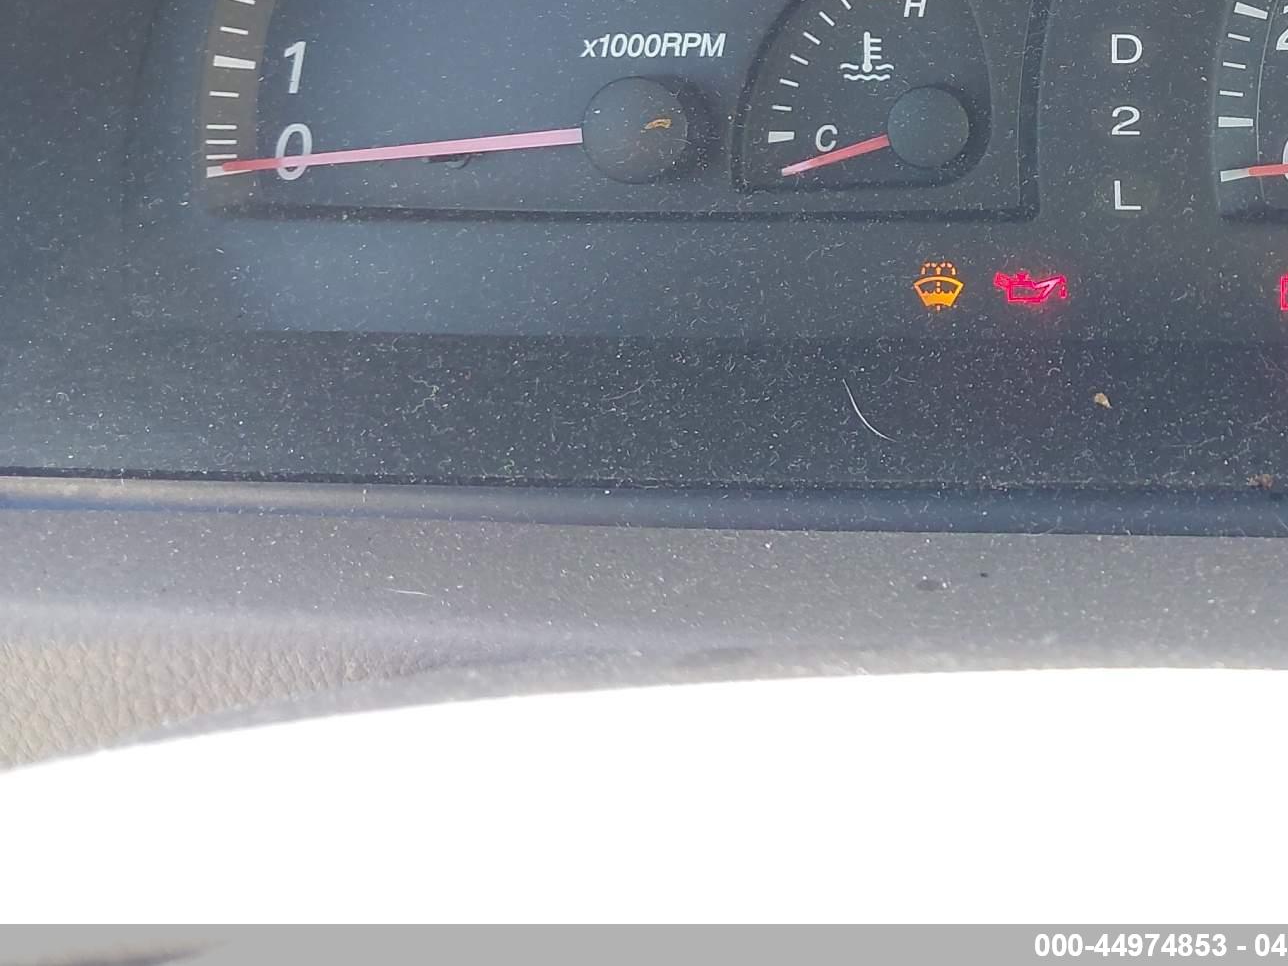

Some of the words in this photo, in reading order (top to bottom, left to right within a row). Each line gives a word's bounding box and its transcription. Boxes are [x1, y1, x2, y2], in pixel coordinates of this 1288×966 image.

[580, 33, 726, 58] x1000RPM
[1113, 35, 1142, 63] D
[283, 41, 306, 93] 1
[1112, 107, 1140, 136] 2
[275, 123, 312, 180] 0
[816, 125, 837, 151] C
[1114, 182, 1141, 210] L
